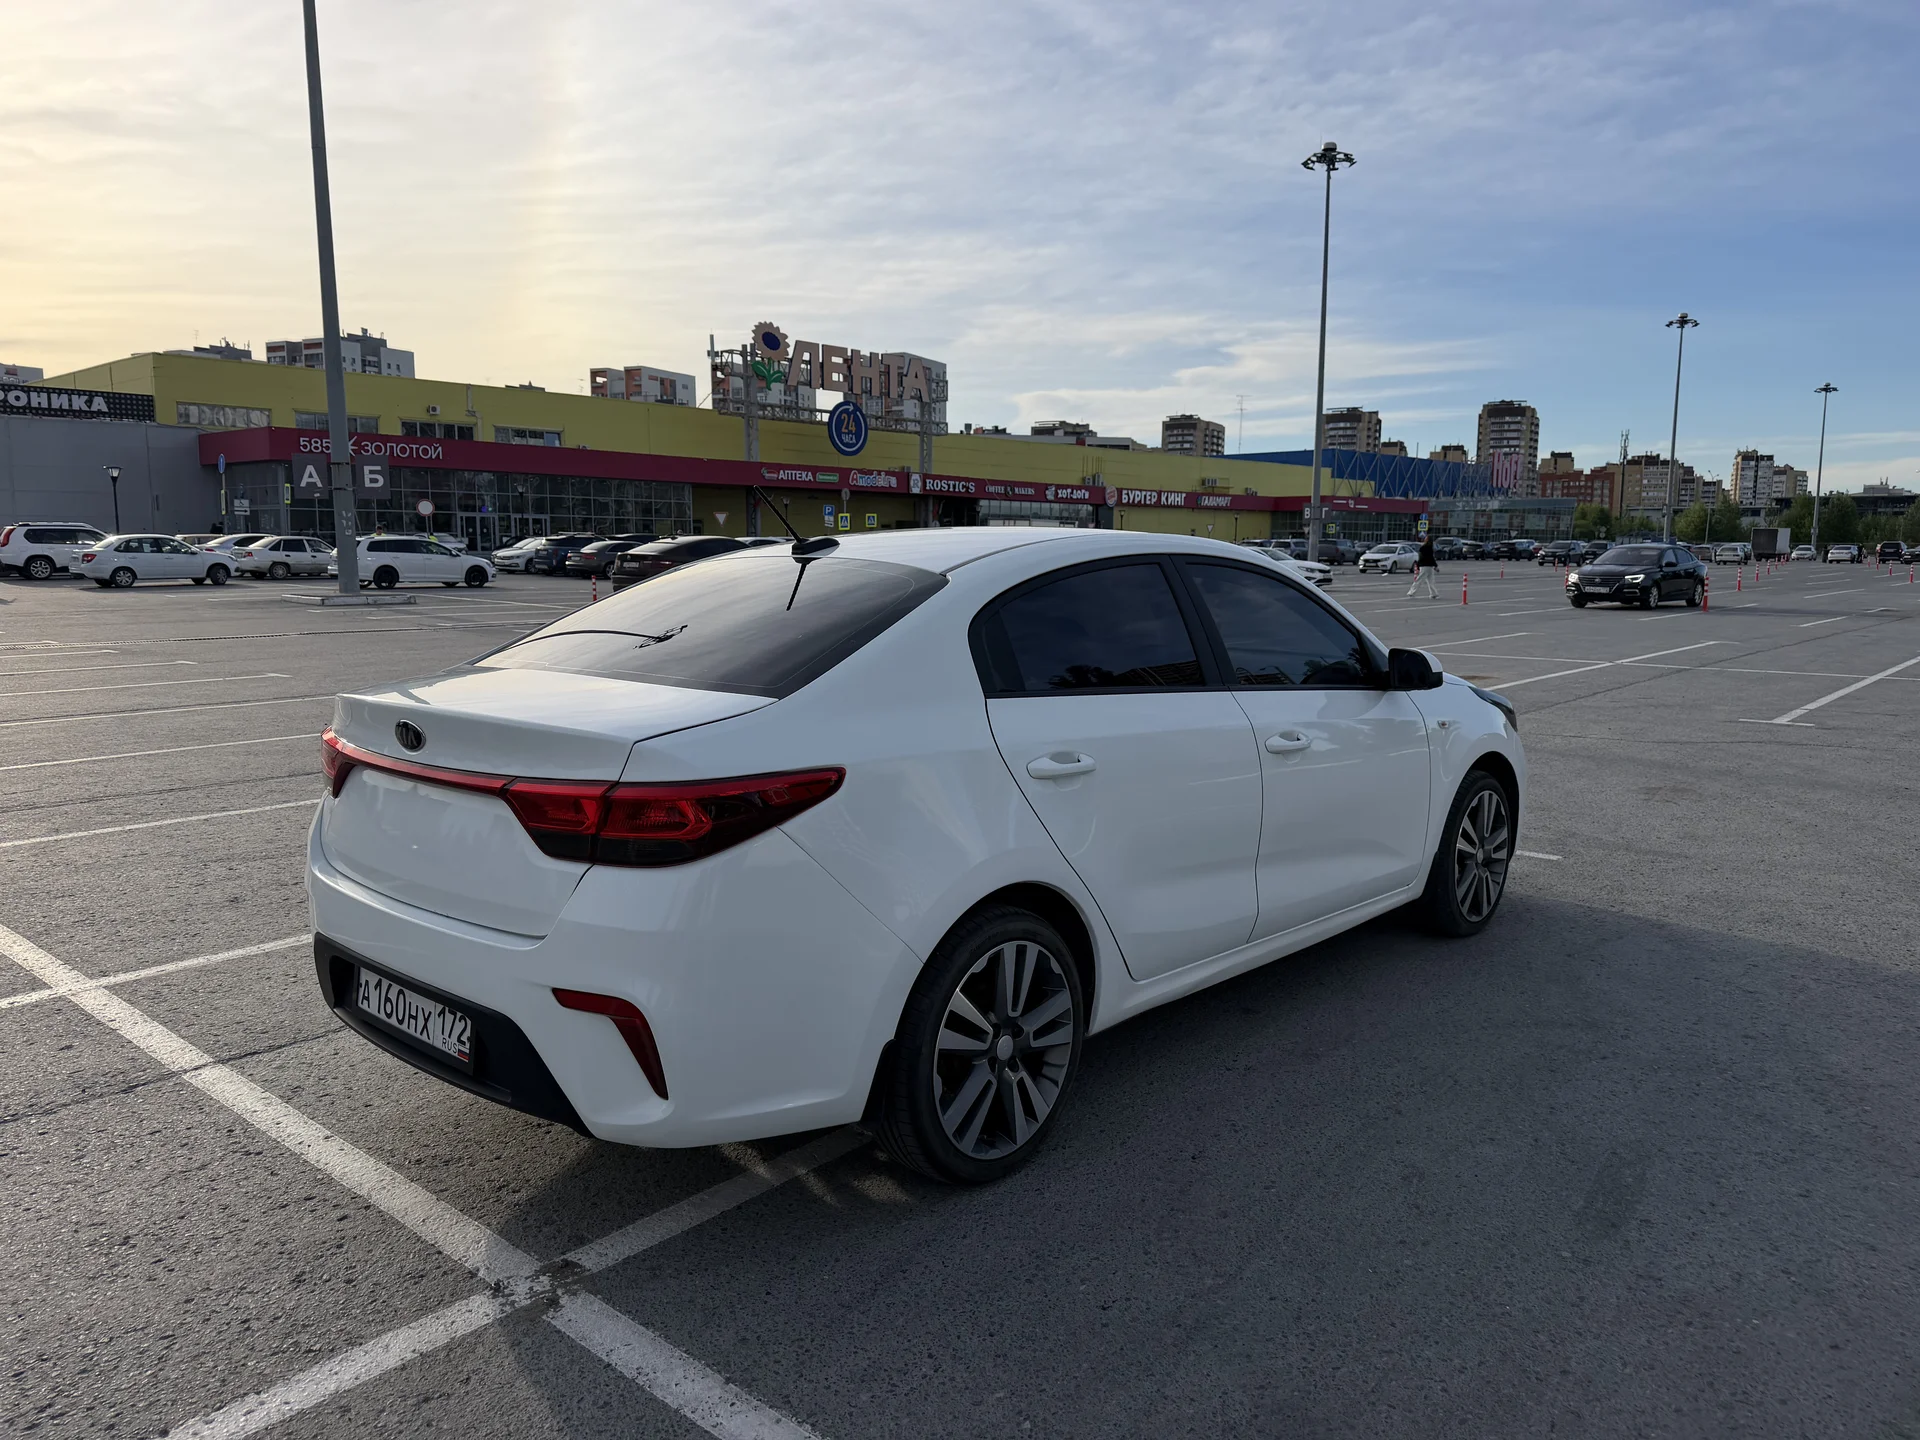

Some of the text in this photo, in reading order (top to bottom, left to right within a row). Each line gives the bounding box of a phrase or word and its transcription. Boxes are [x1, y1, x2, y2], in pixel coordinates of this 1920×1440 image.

[787, 340, 930, 402] ЛЕНТА
[841, 413, 857, 433] 24
[841, 433, 857, 444] ЧАСА
[300, 437, 443, 459] 585 ЗОЛОТОЙ
[300, 465, 323, 487] А
[363, 465, 384, 488] Б
[779, 469, 813, 481] АПТЕКА
[925, 479, 976, 493] ROSTIC'S
[985, 485, 1035, 495] COFFEE MAKERS
[1121, 489, 1158, 505] БУРГЕР
[1161, 491, 1187, 506] КИНГ
[1201, 495, 1232, 507] ГАЛАМАРТ
[361, 978, 468, 1046] А160НХ 172
[441, 1037, 458, 1054] RUS
